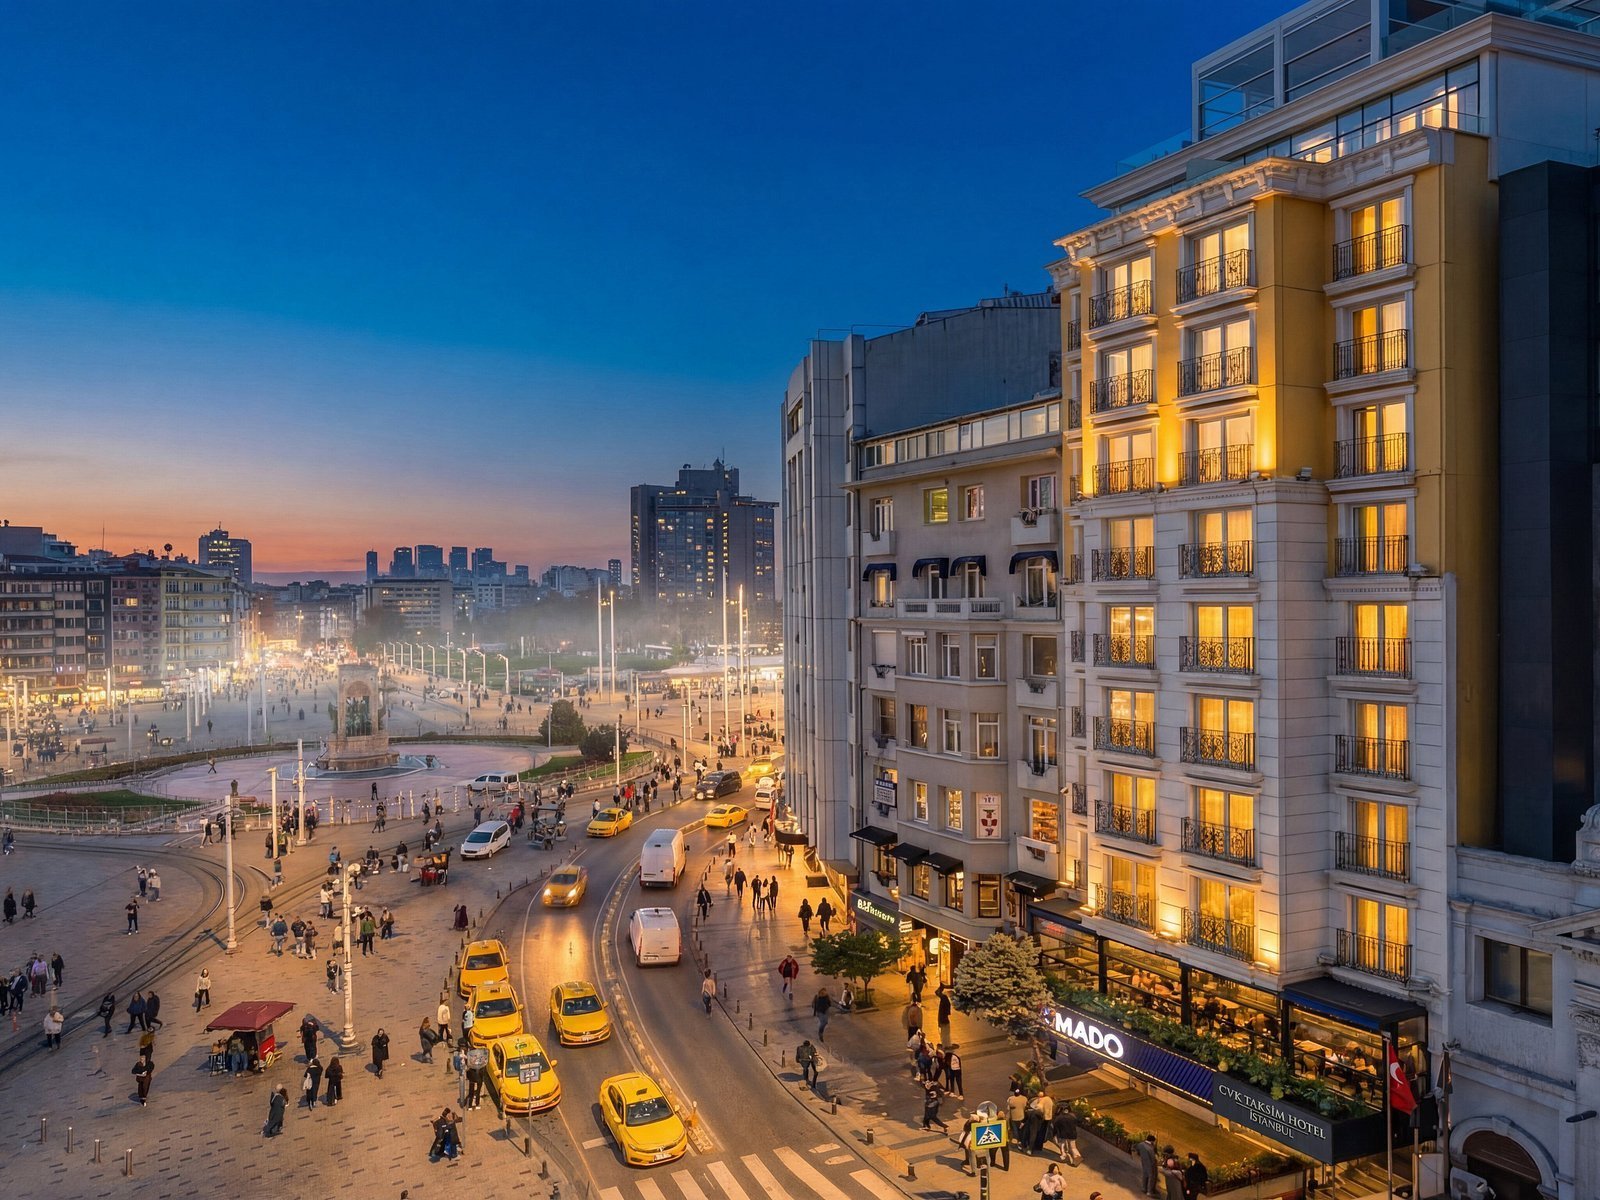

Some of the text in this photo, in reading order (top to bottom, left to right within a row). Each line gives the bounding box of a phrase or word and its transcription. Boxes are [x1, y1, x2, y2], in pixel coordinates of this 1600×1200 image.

[1055, 1012, 1124, 1058] MADO
[1218, 1084, 1326, 1140] CVK TAKSİM HOTEL
[1249, 1109, 1294, 1139] İSTANBUL
